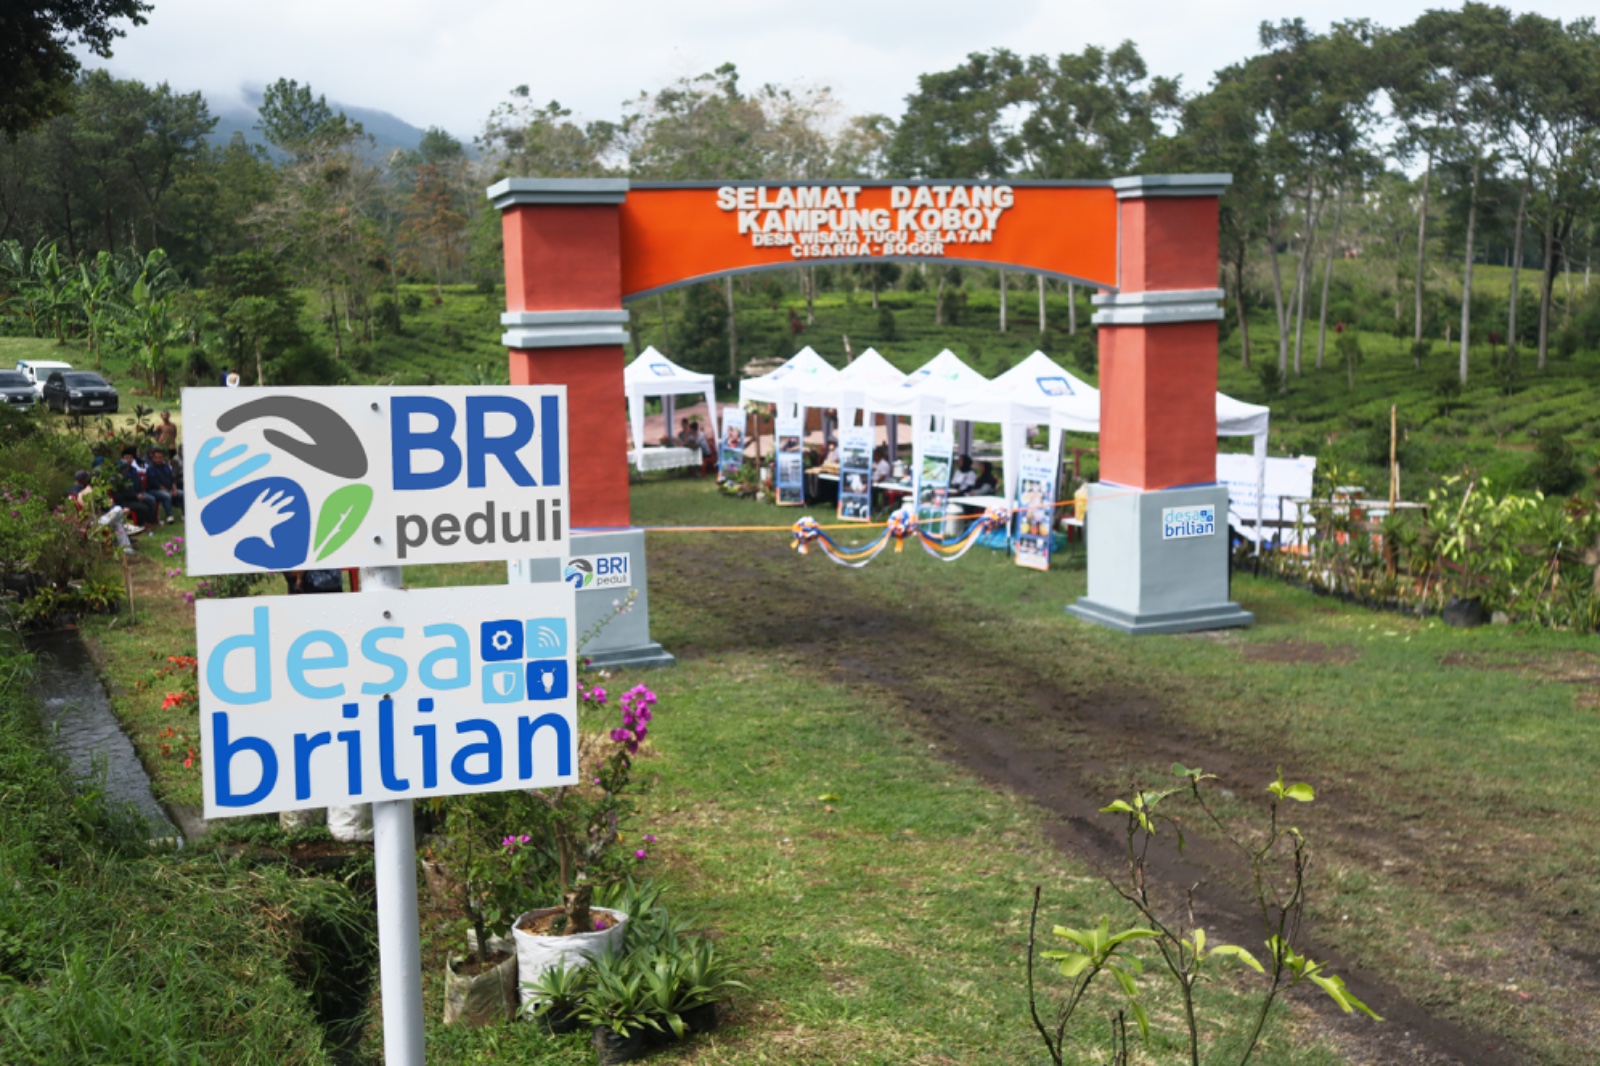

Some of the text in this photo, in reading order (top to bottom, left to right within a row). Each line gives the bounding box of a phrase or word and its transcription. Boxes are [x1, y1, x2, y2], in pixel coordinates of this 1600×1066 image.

[717, 186, 1014, 210] SELAMAT DATANG
[738, 208, 1003, 234] KAMPUNG KOBOY
[752, 230, 992, 247] DESA WISATA TUGU SELATAN
[791, 244, 871, 257] CISARUA
[883, 242, 944, 255] BOGOR
[390, 395, 561, 491] BRI
[1165, 509, 1199, 524] desa
[396, 499, 562, 559] peduli
[1165, 521, 1214, 537] brilian
[597, 556, 628, 575] BRI
[597, 574, 627, 586] peduli
[206, 606, 472, 706] desa
[212, 697, 572, 808] brilian
